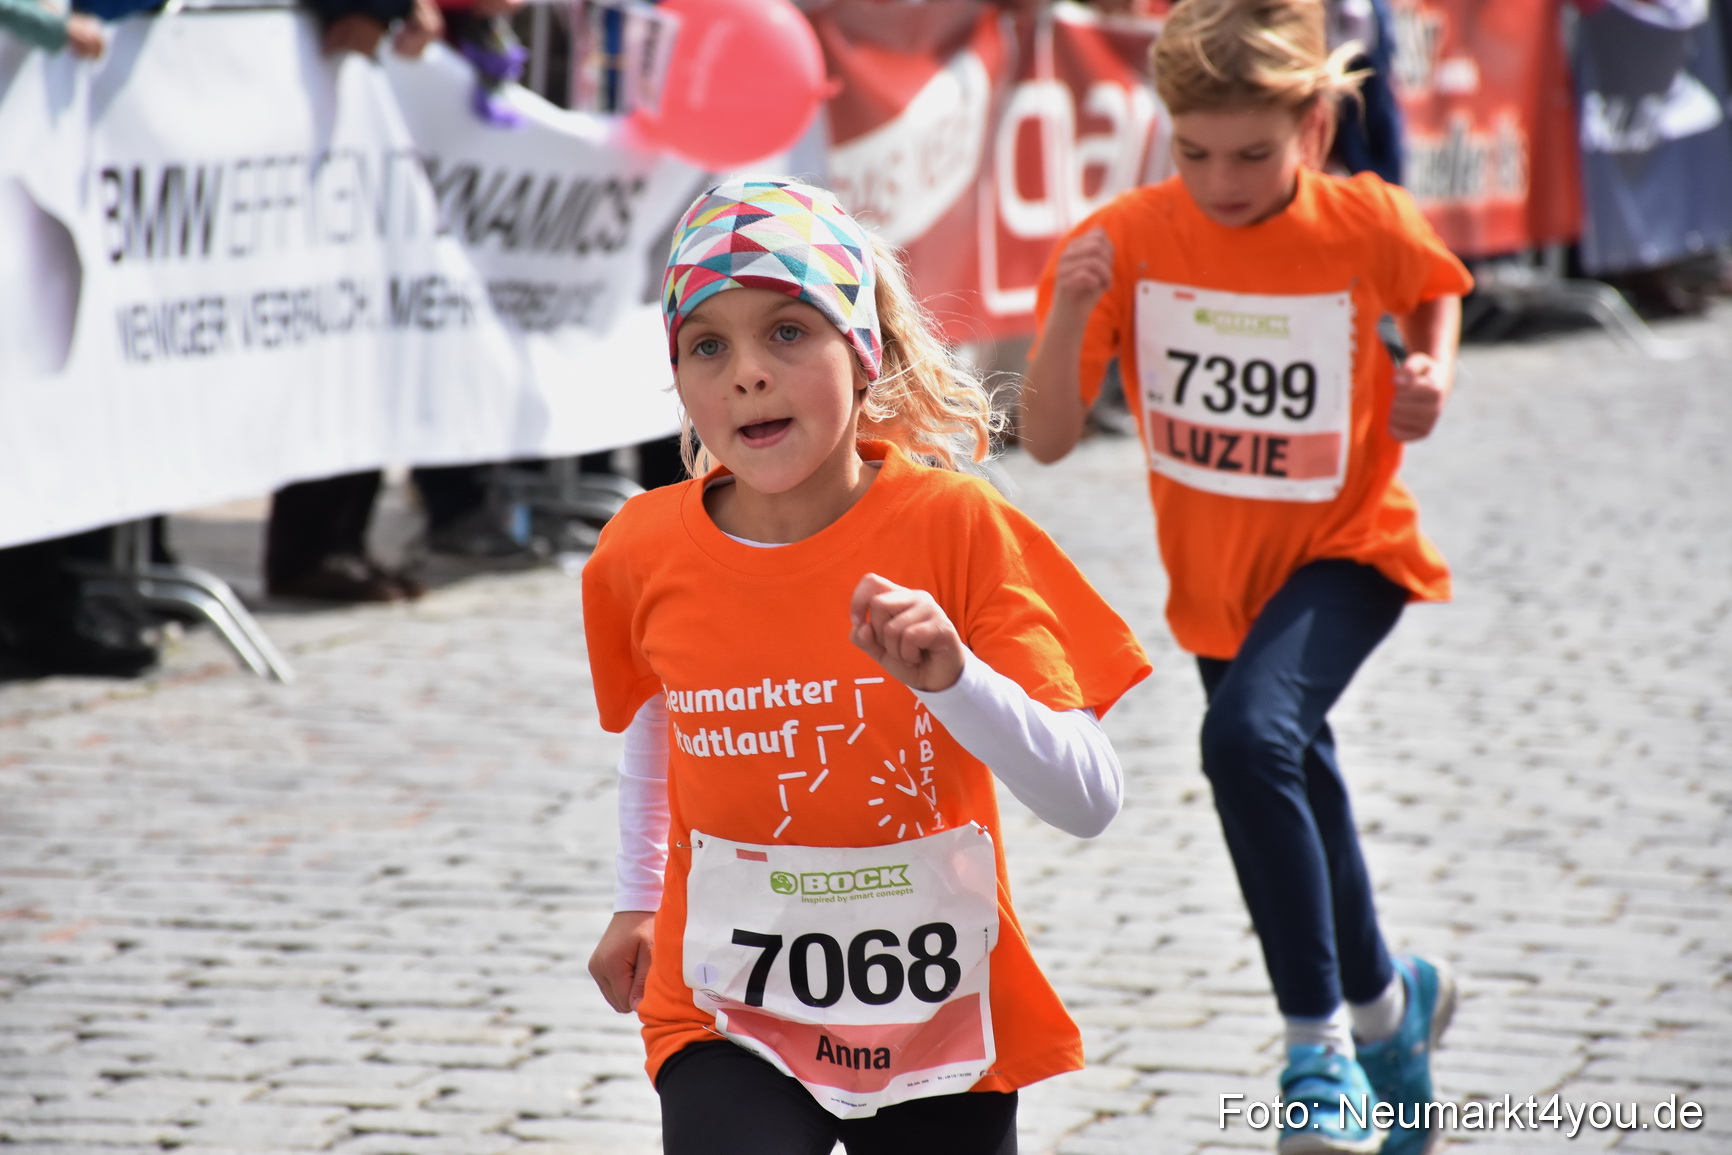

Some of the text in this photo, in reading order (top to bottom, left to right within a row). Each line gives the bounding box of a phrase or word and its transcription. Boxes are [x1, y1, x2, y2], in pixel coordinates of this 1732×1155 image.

[1166, 348, 1317, 422] 7399
[1166, 419, 1290, 478] LUZIE
[801, 864, 912, 895] BOCK
[801, 887, 914, 905] inspired by smart concepts
[731, 922, 962, 1009] 7068
[815, 1035, 892, 1070] Anna
